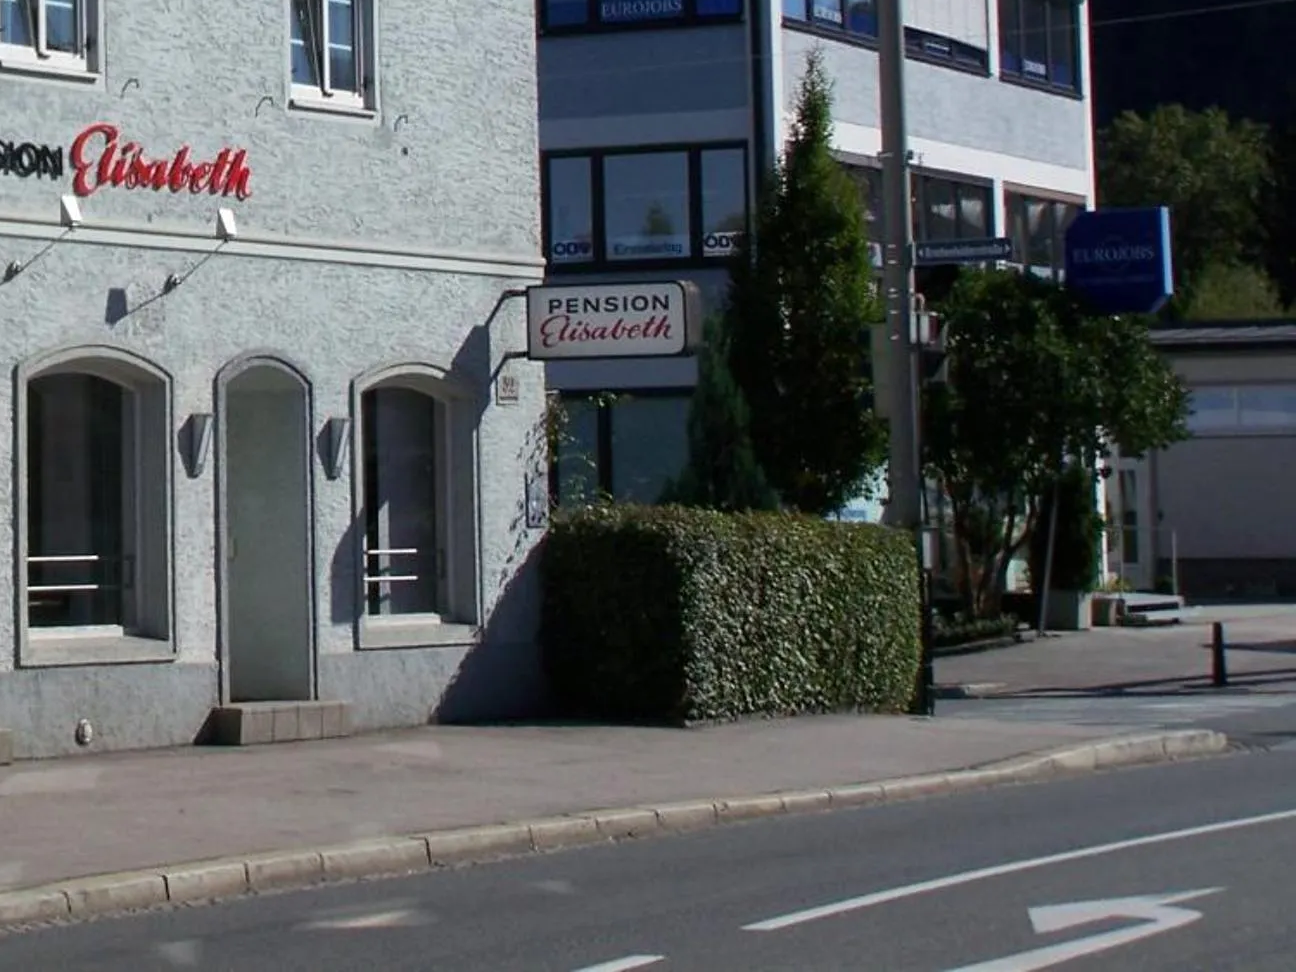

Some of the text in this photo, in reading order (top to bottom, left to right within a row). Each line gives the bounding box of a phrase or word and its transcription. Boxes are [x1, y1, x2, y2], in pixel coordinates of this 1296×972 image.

[70, 122, 253, 202] Elisabeth
[548, 294, 670, 314] PENSION
[539, 314, 673, 349] Elisabeth
